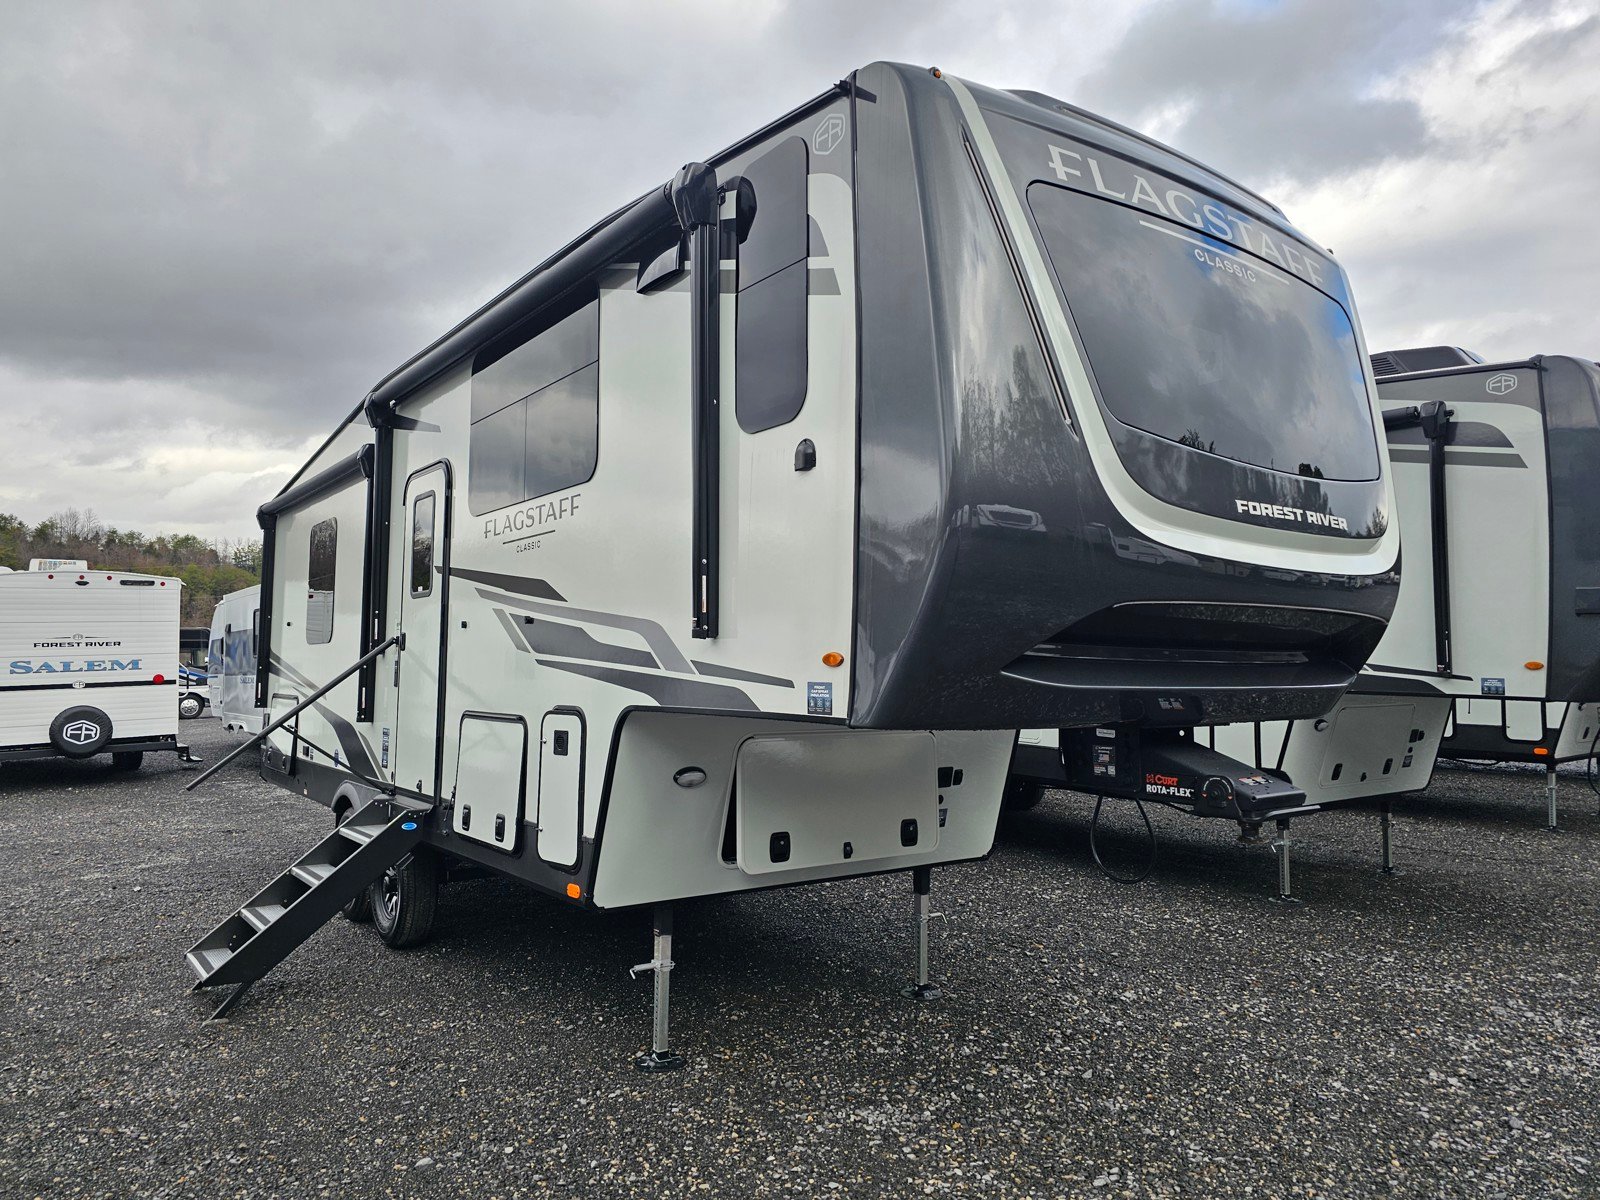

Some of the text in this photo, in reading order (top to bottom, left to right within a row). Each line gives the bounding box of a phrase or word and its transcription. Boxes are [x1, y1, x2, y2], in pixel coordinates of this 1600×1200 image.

[1047, 143, 1324, 285] FLAGSTAFF
[1194, 248, 1257, 283] CLASSIC
[483, 493, 581, 539] FLAGSTAFF
[1235, 499, 1349, 531] FOREST RIVER
[515, 540, 541, 553] CLASSIC
[9, 659, 142, 674] SALEM
[67, 723, 97, 742] FR
